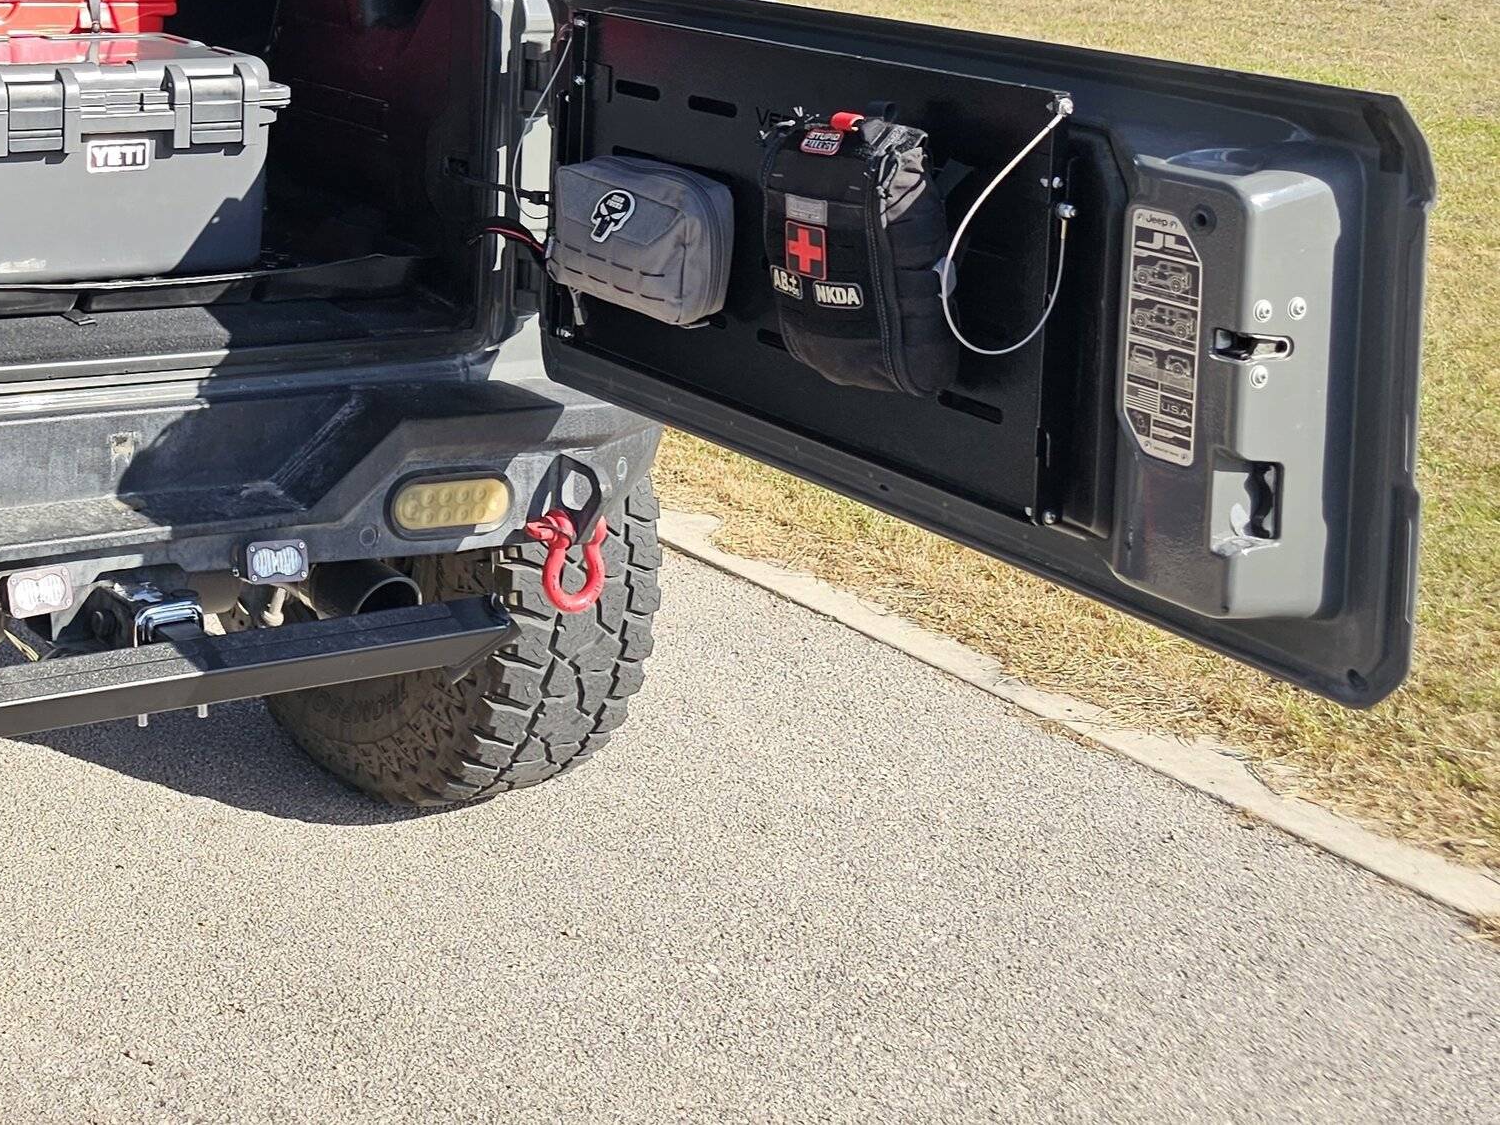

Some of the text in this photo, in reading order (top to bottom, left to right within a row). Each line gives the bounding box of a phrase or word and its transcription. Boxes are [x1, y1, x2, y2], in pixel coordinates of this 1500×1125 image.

[91, 142, 146, 167] YETI
[1146, 215, 1168, 227] Jeep
[1136, 232, 1192, 253] JL
[815, 284, 861, 306] NKDA
[1161, 401, 1191, 419] USA
